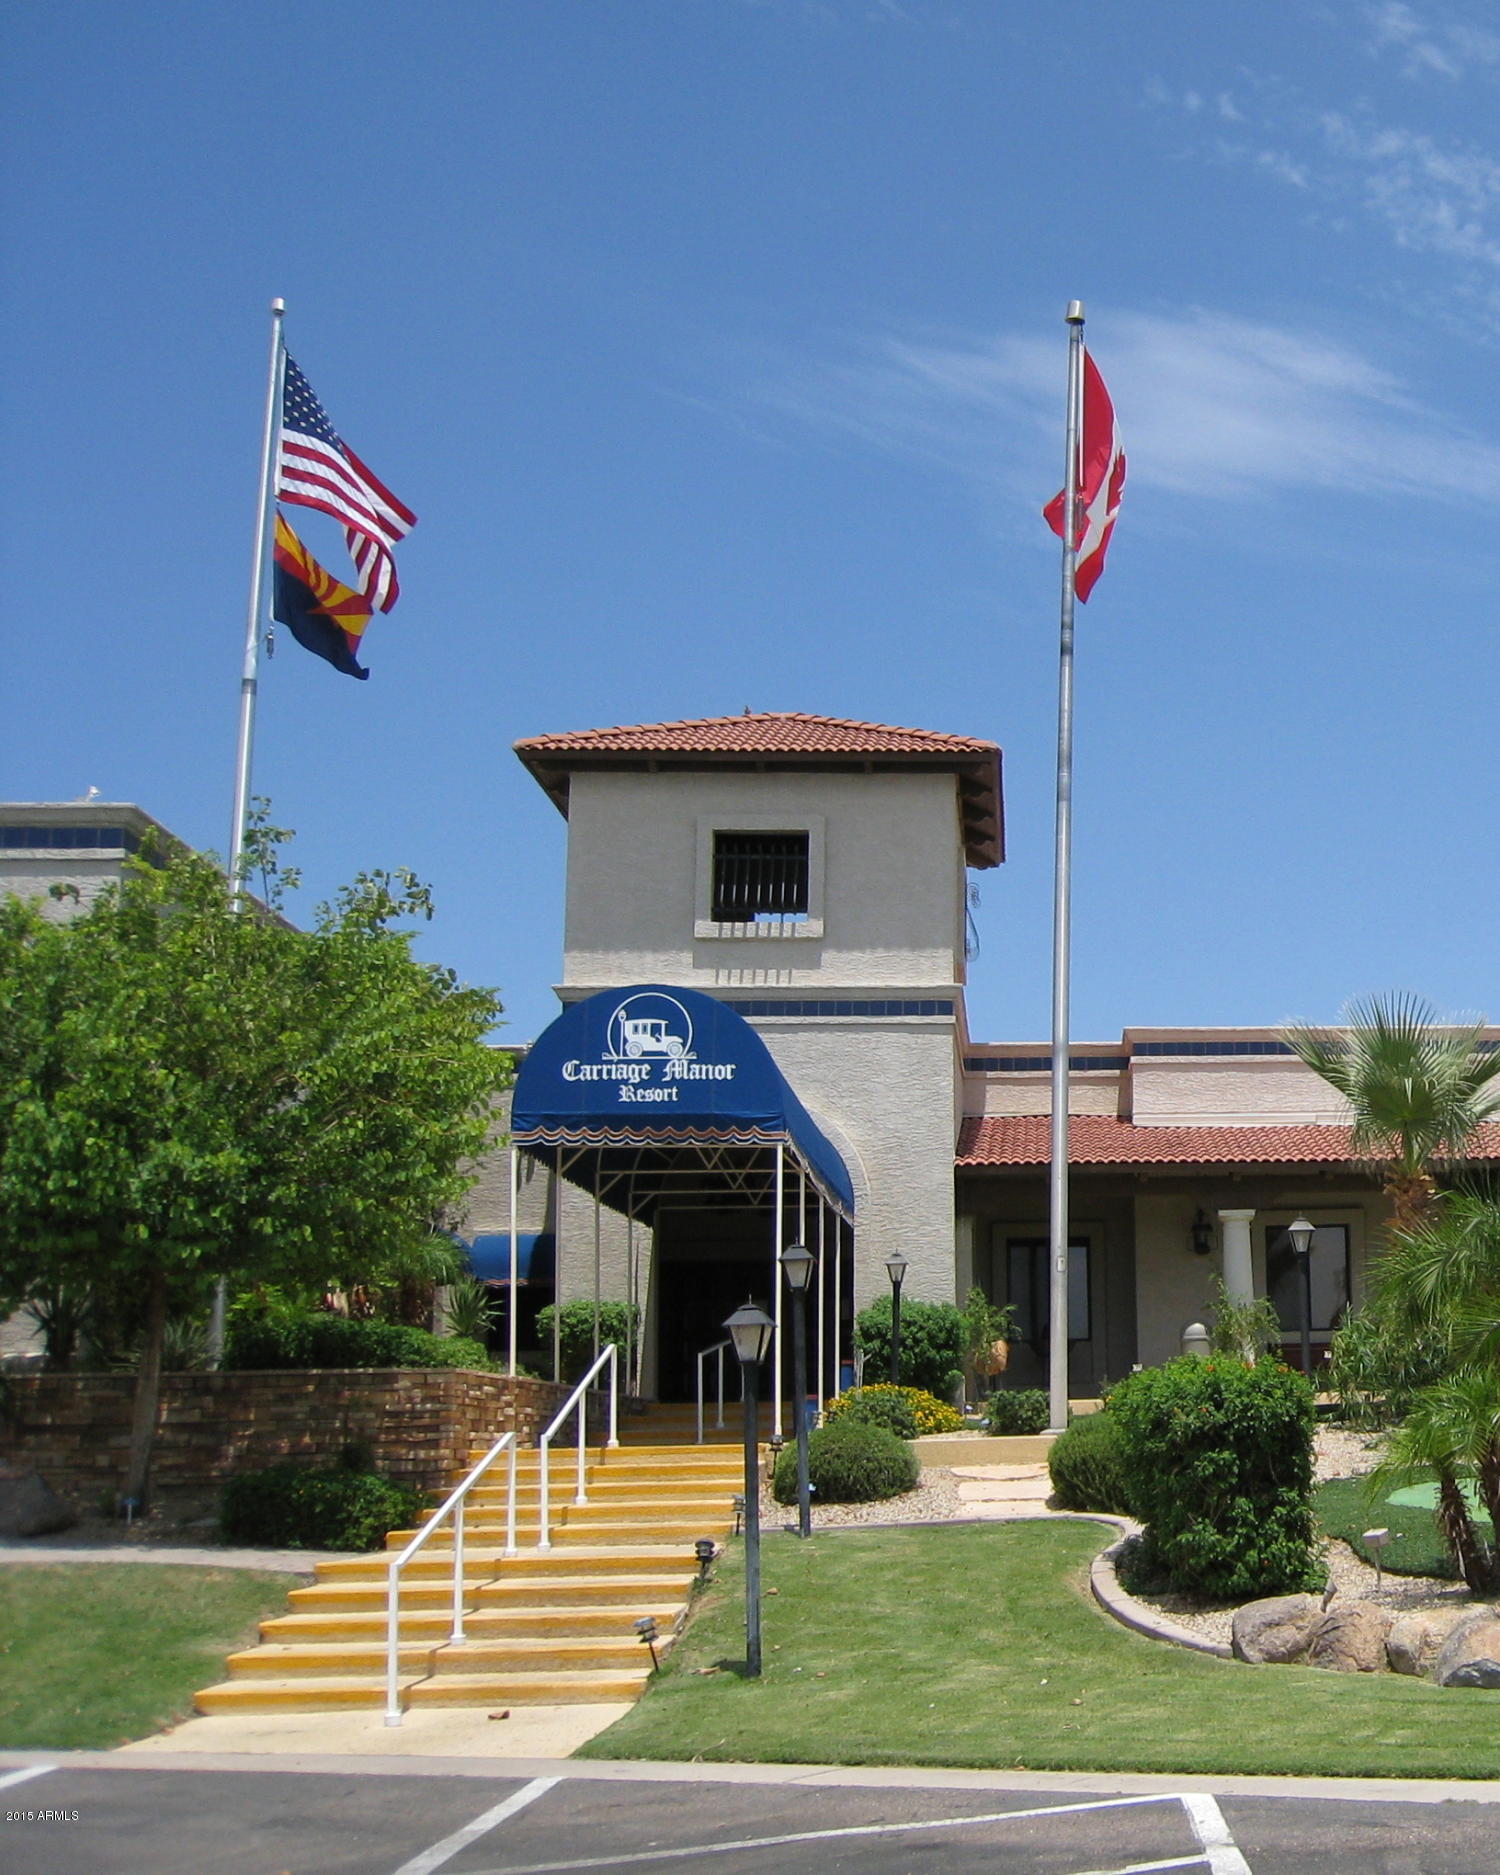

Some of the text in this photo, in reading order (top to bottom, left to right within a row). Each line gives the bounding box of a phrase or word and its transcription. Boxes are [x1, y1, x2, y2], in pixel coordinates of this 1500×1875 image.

[561, 1059, 737, 1083] Carriage Manor
[617, 1084, 679, 1102] Resort
